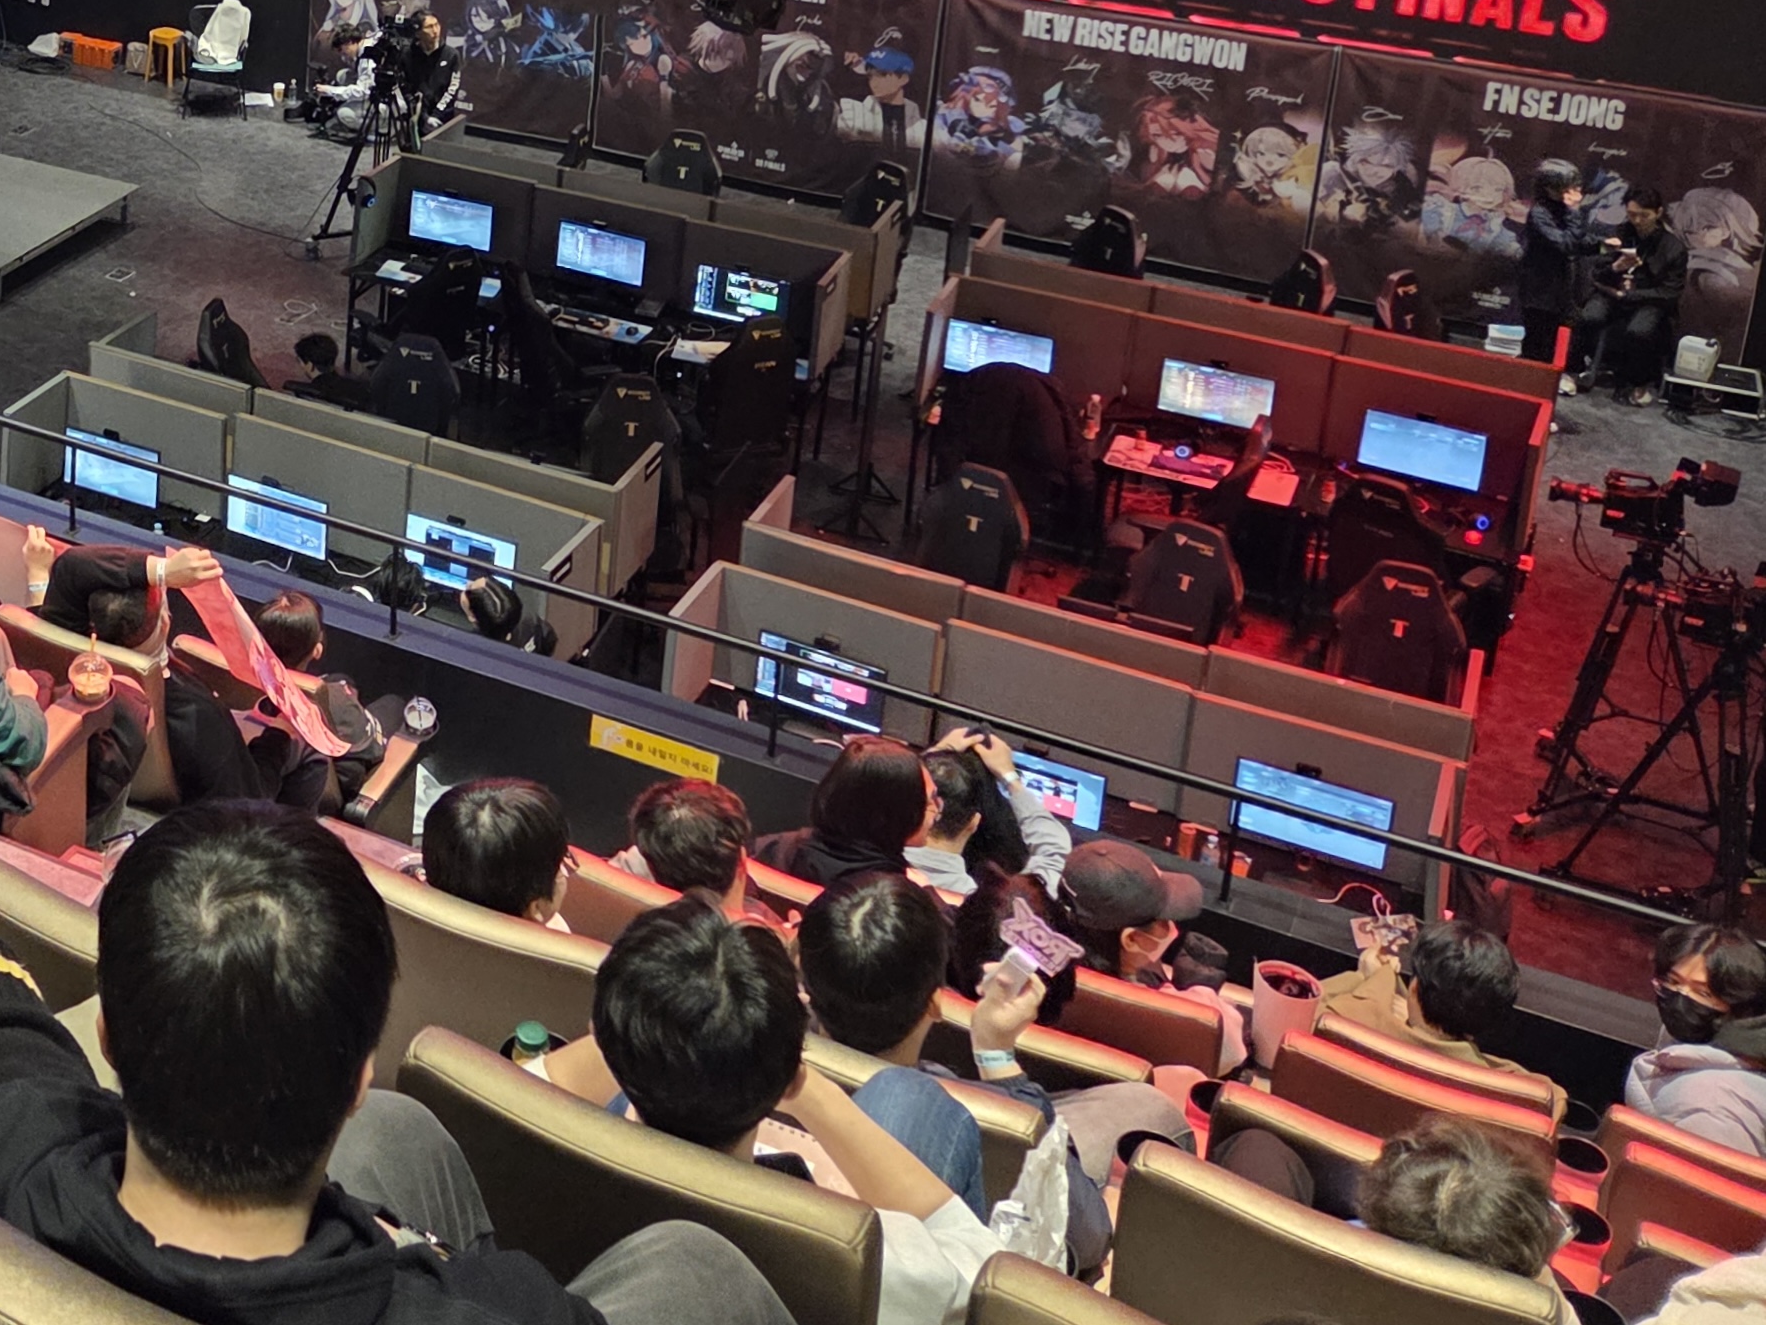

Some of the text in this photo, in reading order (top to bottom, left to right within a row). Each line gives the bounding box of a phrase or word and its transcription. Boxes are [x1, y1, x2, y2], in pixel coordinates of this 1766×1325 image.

[1022, 9, 1074, 43] NEW
[1074, 17, 1128, 53] RISE
[1128, 26, 1248, 72] GANGWON
[1483, 81, 1626, 131] FN SEJONG
